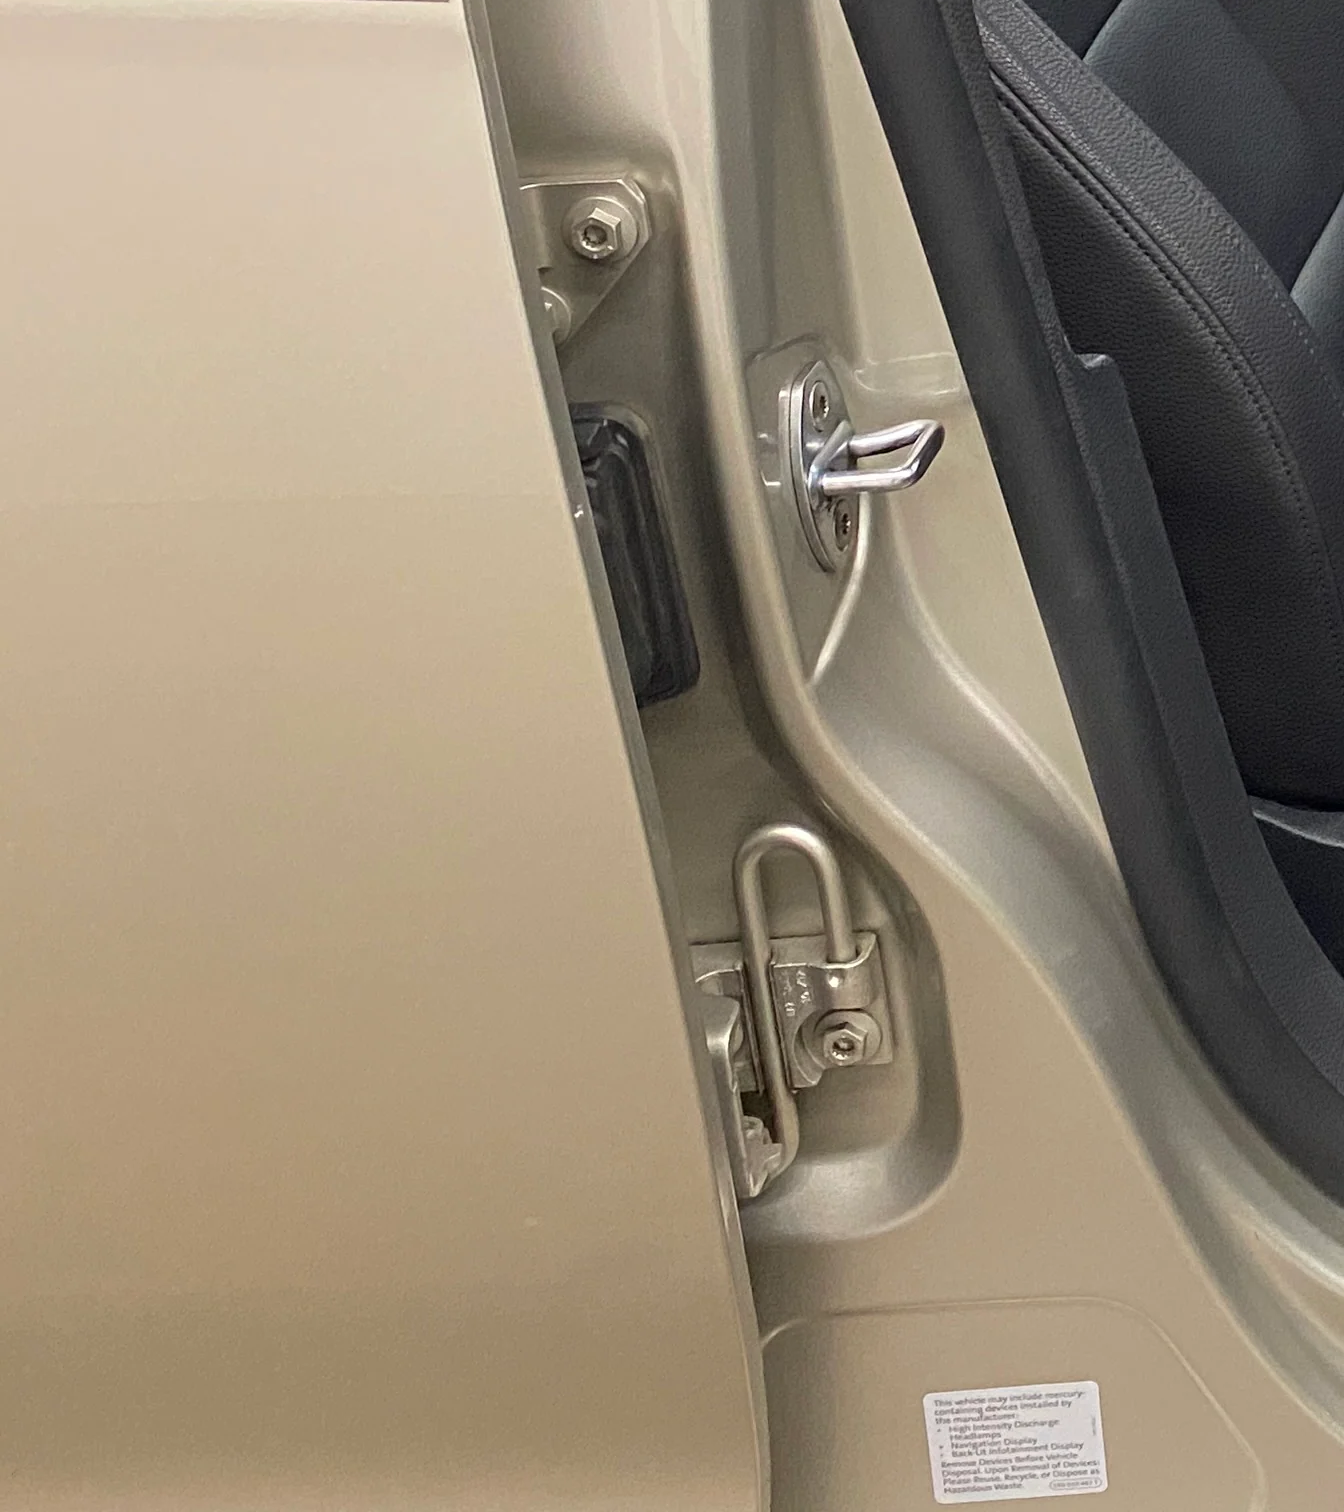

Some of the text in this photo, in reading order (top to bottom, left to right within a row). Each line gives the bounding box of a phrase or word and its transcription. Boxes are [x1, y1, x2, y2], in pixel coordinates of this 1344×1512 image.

[934, 1399, 952, 1407] This
[955, 1397, 986, 1406] vehicle
[987, 1396, 1008, 1405] may
[1010, 1393, 1042, 1402] include
[934, 1407, 983, 1417] containing
[1020, 1400, 1059, 1409] installed
[1061, 1400, 1072, 1408] by
[936, 1417, 951, 1425] the
[949, 1419, 1060, 1433] High Intensity Discharge
[950, 1432, 1002, 1441] Headlamps
[951, 1437, 1037, 1449] Navigation Display
[988, 1444, 1049, 1455] Infotainment
[1050, 1441, 1084, 1451] Display
[979, 1458, 1013, 1466] Devices
[1014, 1454, 1044, 1464] Before
[1045, 1452, 1078, 1461] Vehicle
[984, 1466, 1010, 1475] Upon
[1011, 1463, 1050, 1472] Removal
[1051, 1461, 1062, 1469] of
[943, 1477, 972, 1486] Please
[1041, 1471, 1051, 1479] or
[1052, 1468, 1089, 1478] Dispose
[1090, 1467, 1100, 1475] as
[944, 1485, 993, 1494] Hazardous
